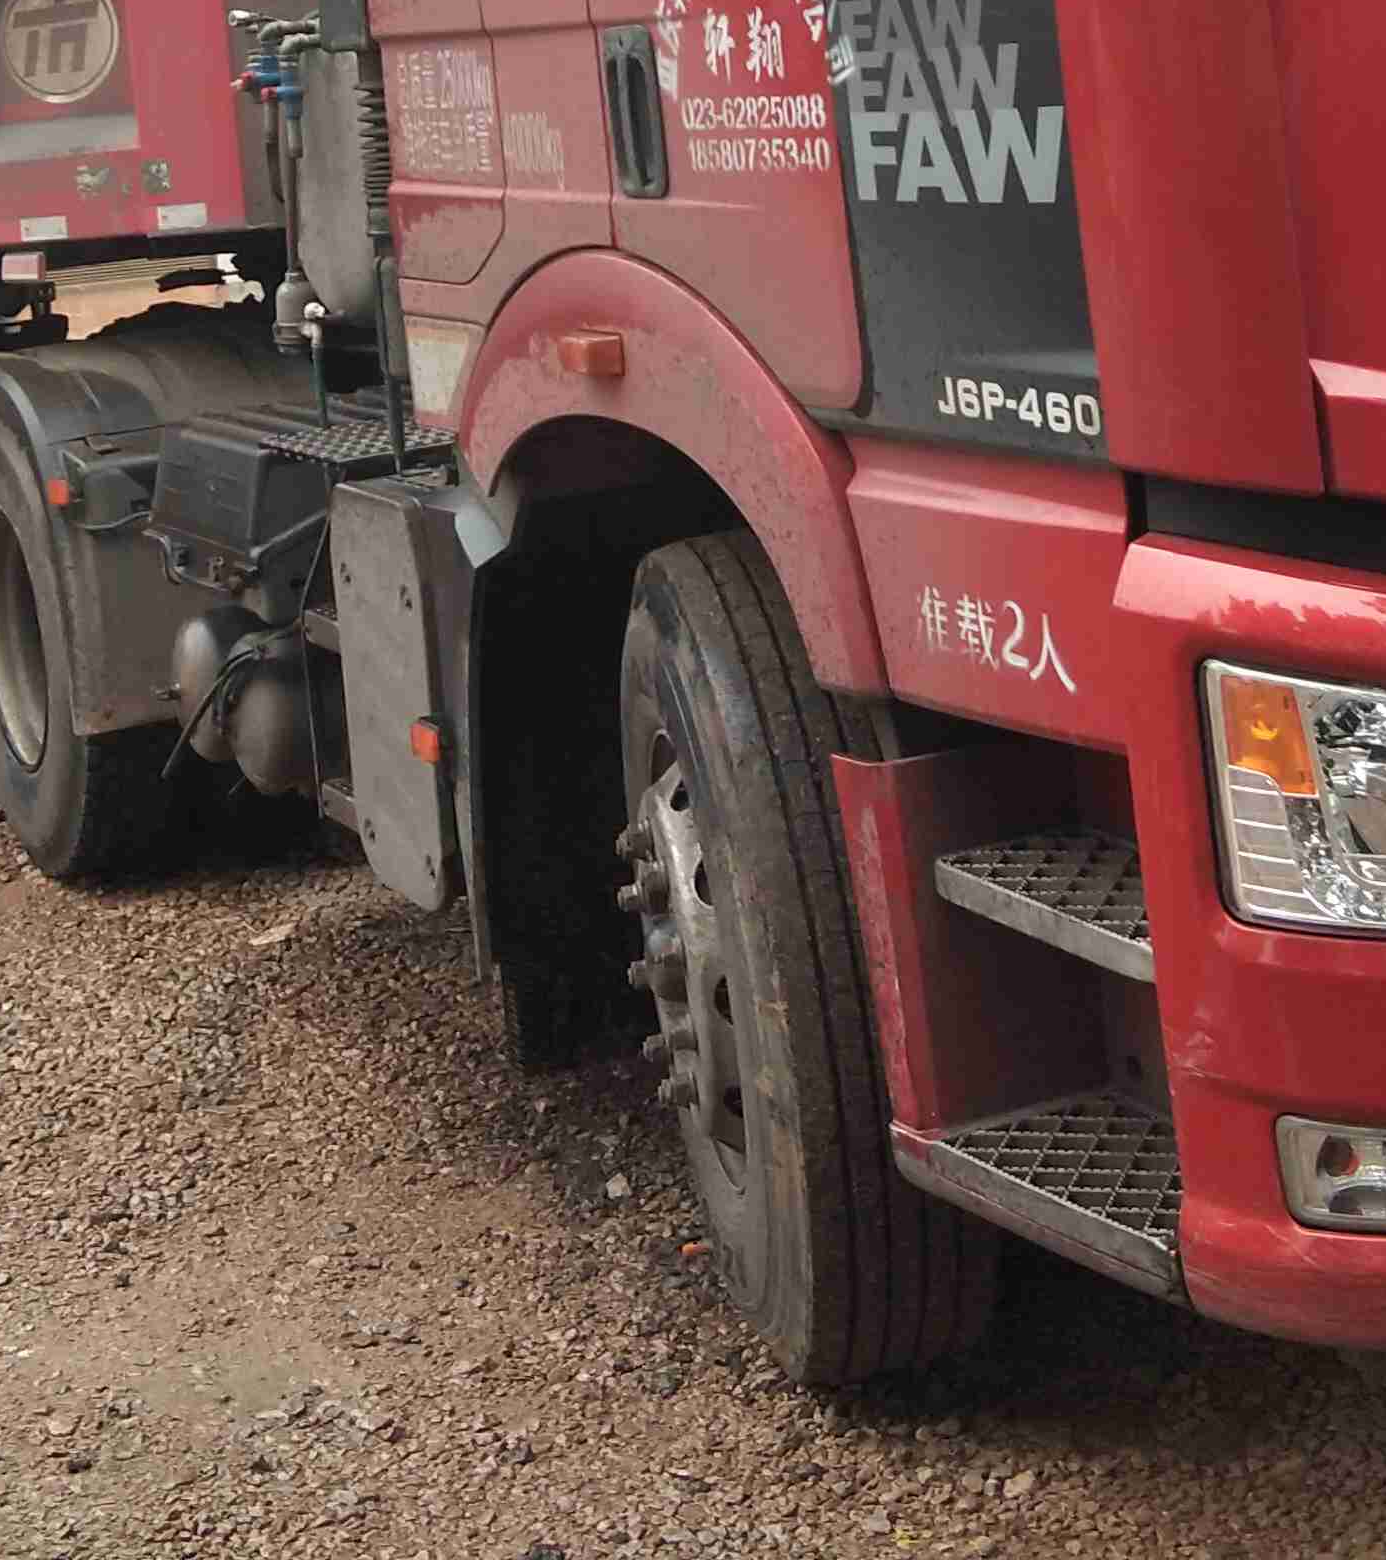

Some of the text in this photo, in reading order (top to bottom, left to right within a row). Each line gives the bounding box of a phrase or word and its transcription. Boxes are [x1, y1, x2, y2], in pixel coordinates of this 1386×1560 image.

[681, 93, 826, 132] 023-62825088
[846, 43, 1020, 130] FAW
[850, 105, 1064, 204] FAW
[938, 376, 1102, 436] J6P-460
[917, 585, 1078, 694] 准载2人
